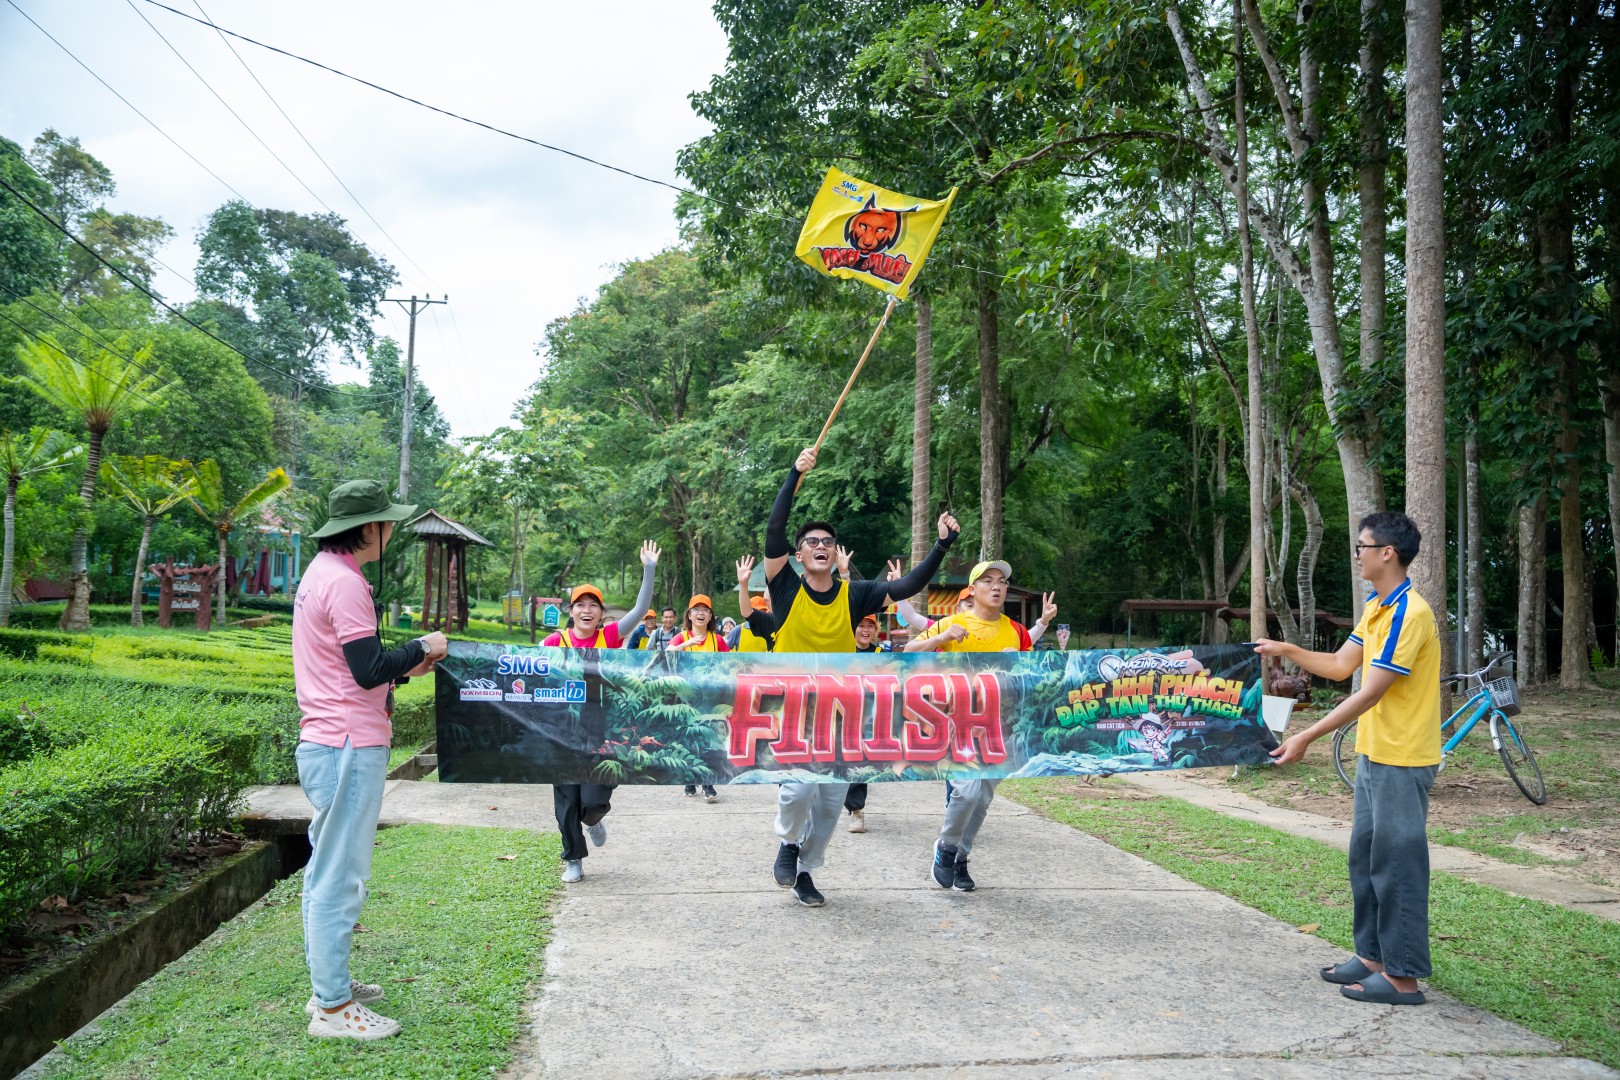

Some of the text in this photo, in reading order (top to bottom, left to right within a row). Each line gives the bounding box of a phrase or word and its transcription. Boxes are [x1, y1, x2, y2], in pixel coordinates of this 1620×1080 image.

[840, 180, 858, 192] SMG
[819, 248, 912, 283] INH MIÊ
[498, 655, 550, 675] SMG
[1113, 658, 1188, 670] AMAZING RACE
[1112, 670, 1155, 697] KHÍ
[1159, 671, 1244, 705] PHÁCH
[726, 673, 1007, 767] FINISH
[1106, 694, 1150, 718] TAN
[1191, 698, 1244, 720] THÁCH
